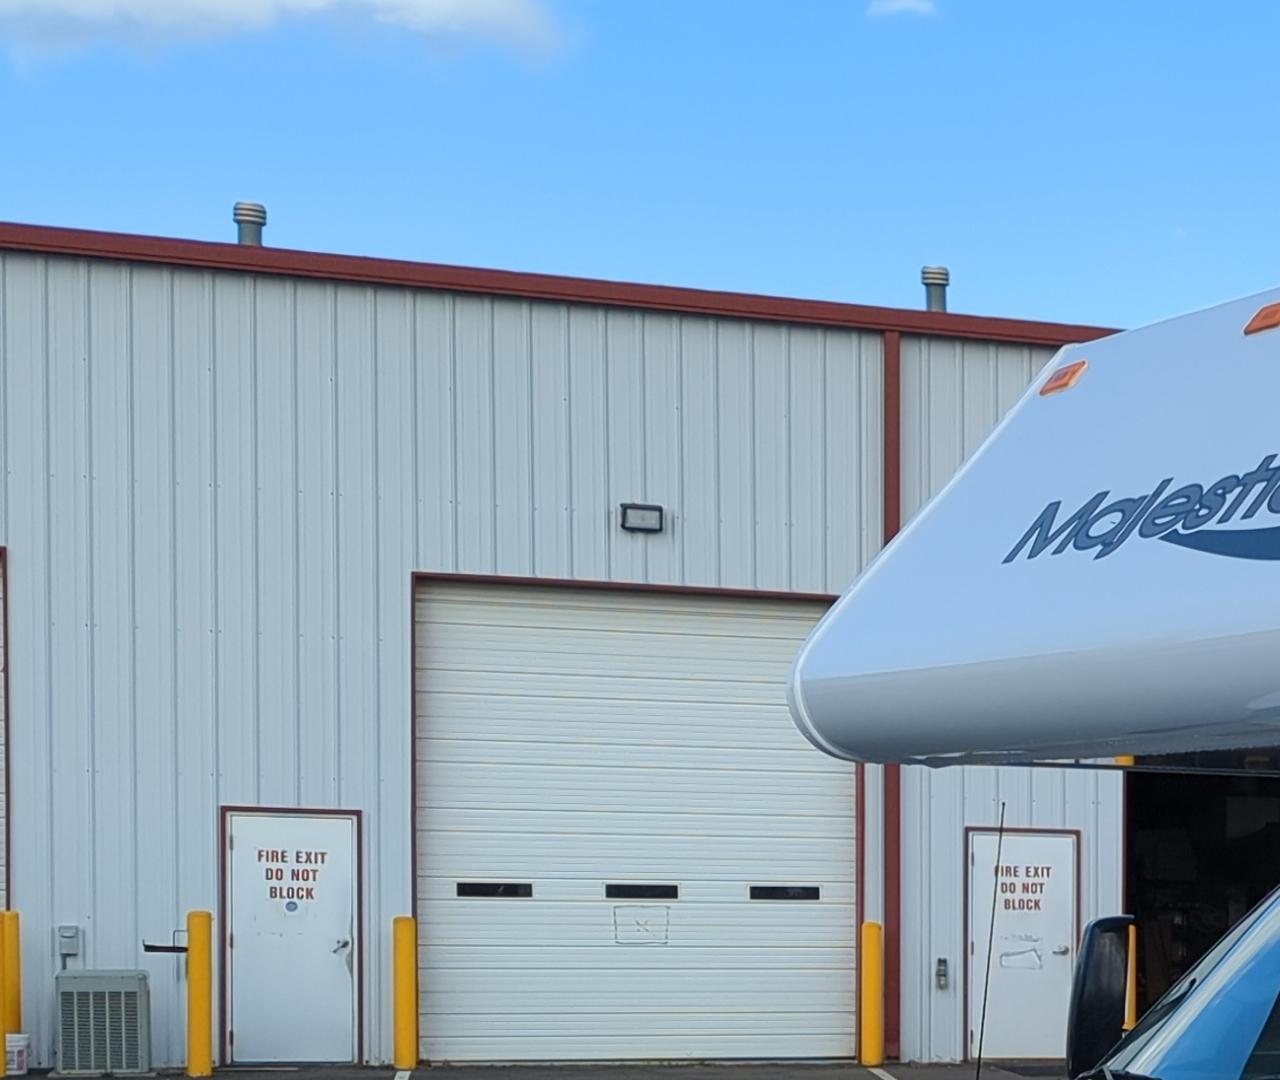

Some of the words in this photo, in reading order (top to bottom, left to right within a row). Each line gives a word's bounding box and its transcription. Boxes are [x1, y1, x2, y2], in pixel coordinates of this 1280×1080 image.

[257, 849, 288, 863] FIRE
[296, 851, 327, 864] EXIT
[265, 868, 284, 881] DO
[291, 869, 319, 882] NOT
[1025, 866, 1052, 878] EXIT
[269, 886, 314, 900] BLOCK
[1000, 882, 1016, 894] DO
[1022, 882, 1045, 894] NOT
[1004, 898, 1041, 911] BLOCK
